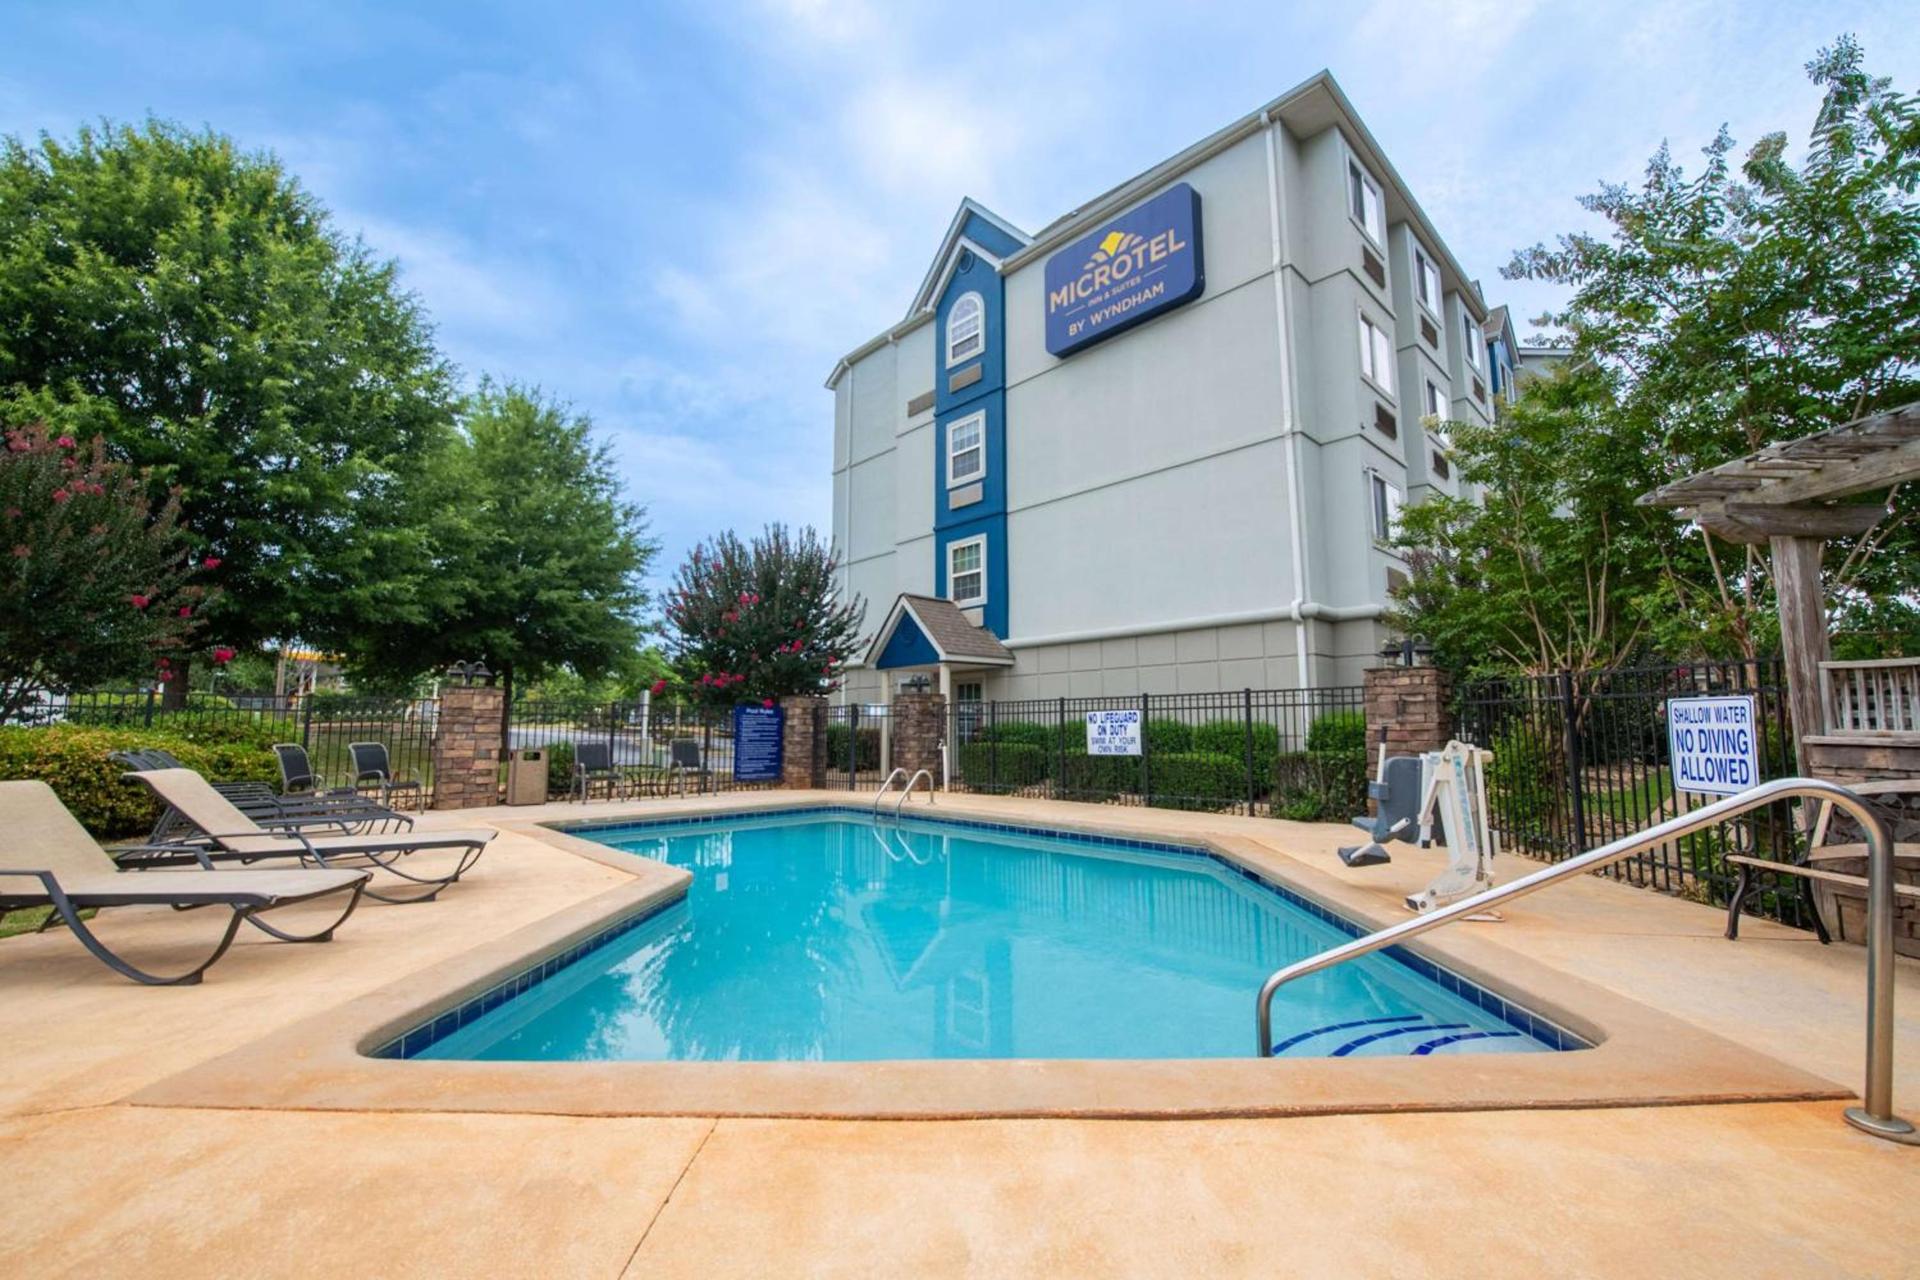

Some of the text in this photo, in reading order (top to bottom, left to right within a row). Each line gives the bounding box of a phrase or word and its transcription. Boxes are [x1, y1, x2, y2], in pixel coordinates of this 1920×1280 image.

[1050, 228, 1186, 313] MICROTEL
[1111, 276, 1141, 296] SUITES
[1068, 281, 1165, 336] BY WYNDHAM
[1088, 711, 1138, 724] NO LIFEGUARD
[1674, 706, 1747, 724] SHALLOW WATER
[1098, 724, 1128, 736] ON DUTY
[1676, 728, 1749, 755] NO DIVING
[1681, 756, 1749, 785] ALLOWED
